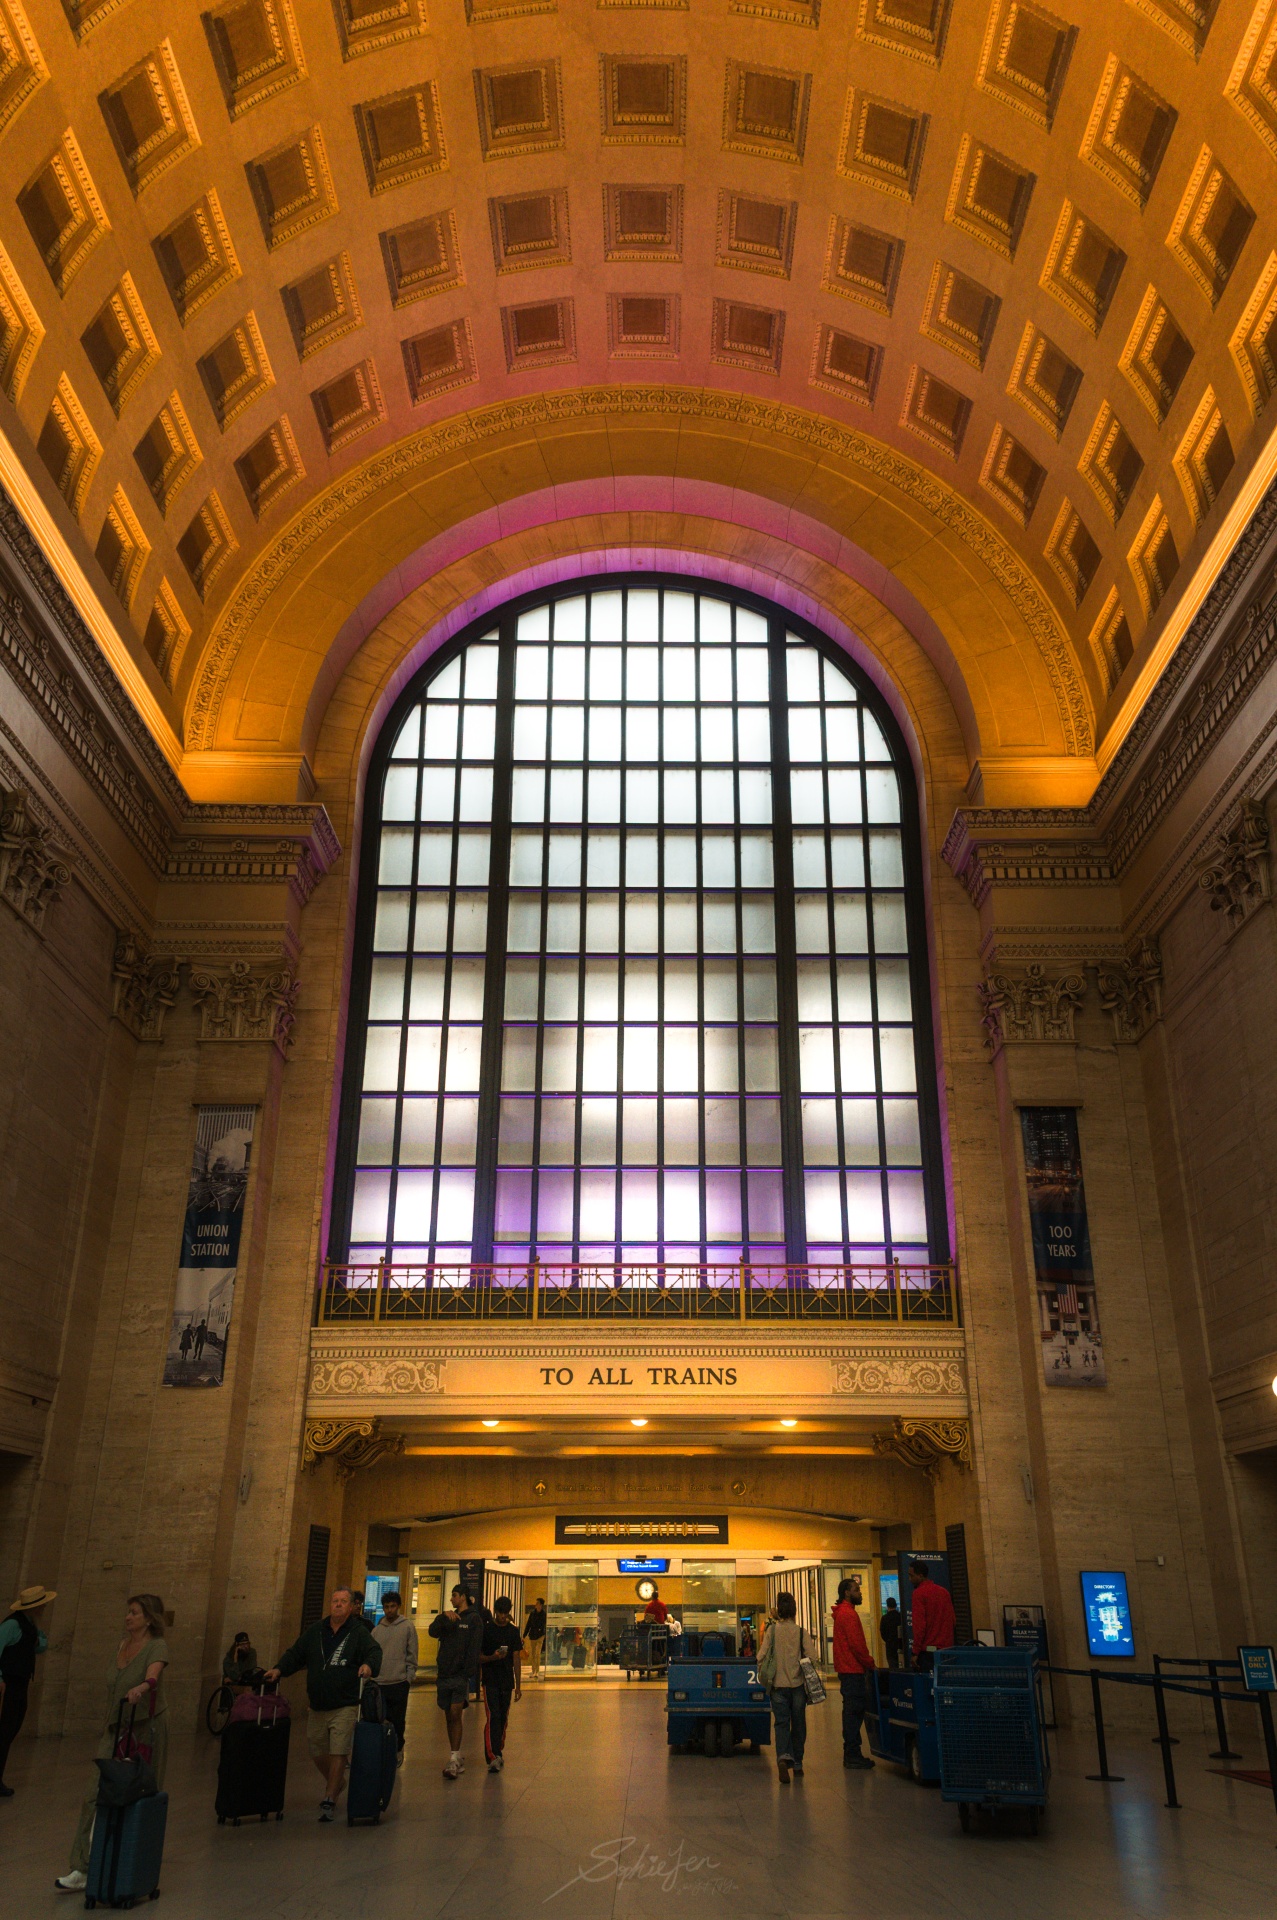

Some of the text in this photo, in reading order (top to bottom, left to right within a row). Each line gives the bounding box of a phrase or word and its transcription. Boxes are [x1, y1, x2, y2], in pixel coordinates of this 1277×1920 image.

[197, 1224, 229, 1237] UNION
[1048, 1225, 1073, 1239] 100
[190, 1243, 231, 1256] STATION
[1046, 1243, 1077, 1257] YEARS
[539, 1367, 738, 1386] TO ALL TRAINS
[585, 1521, 699, 1537] UNION STATION
